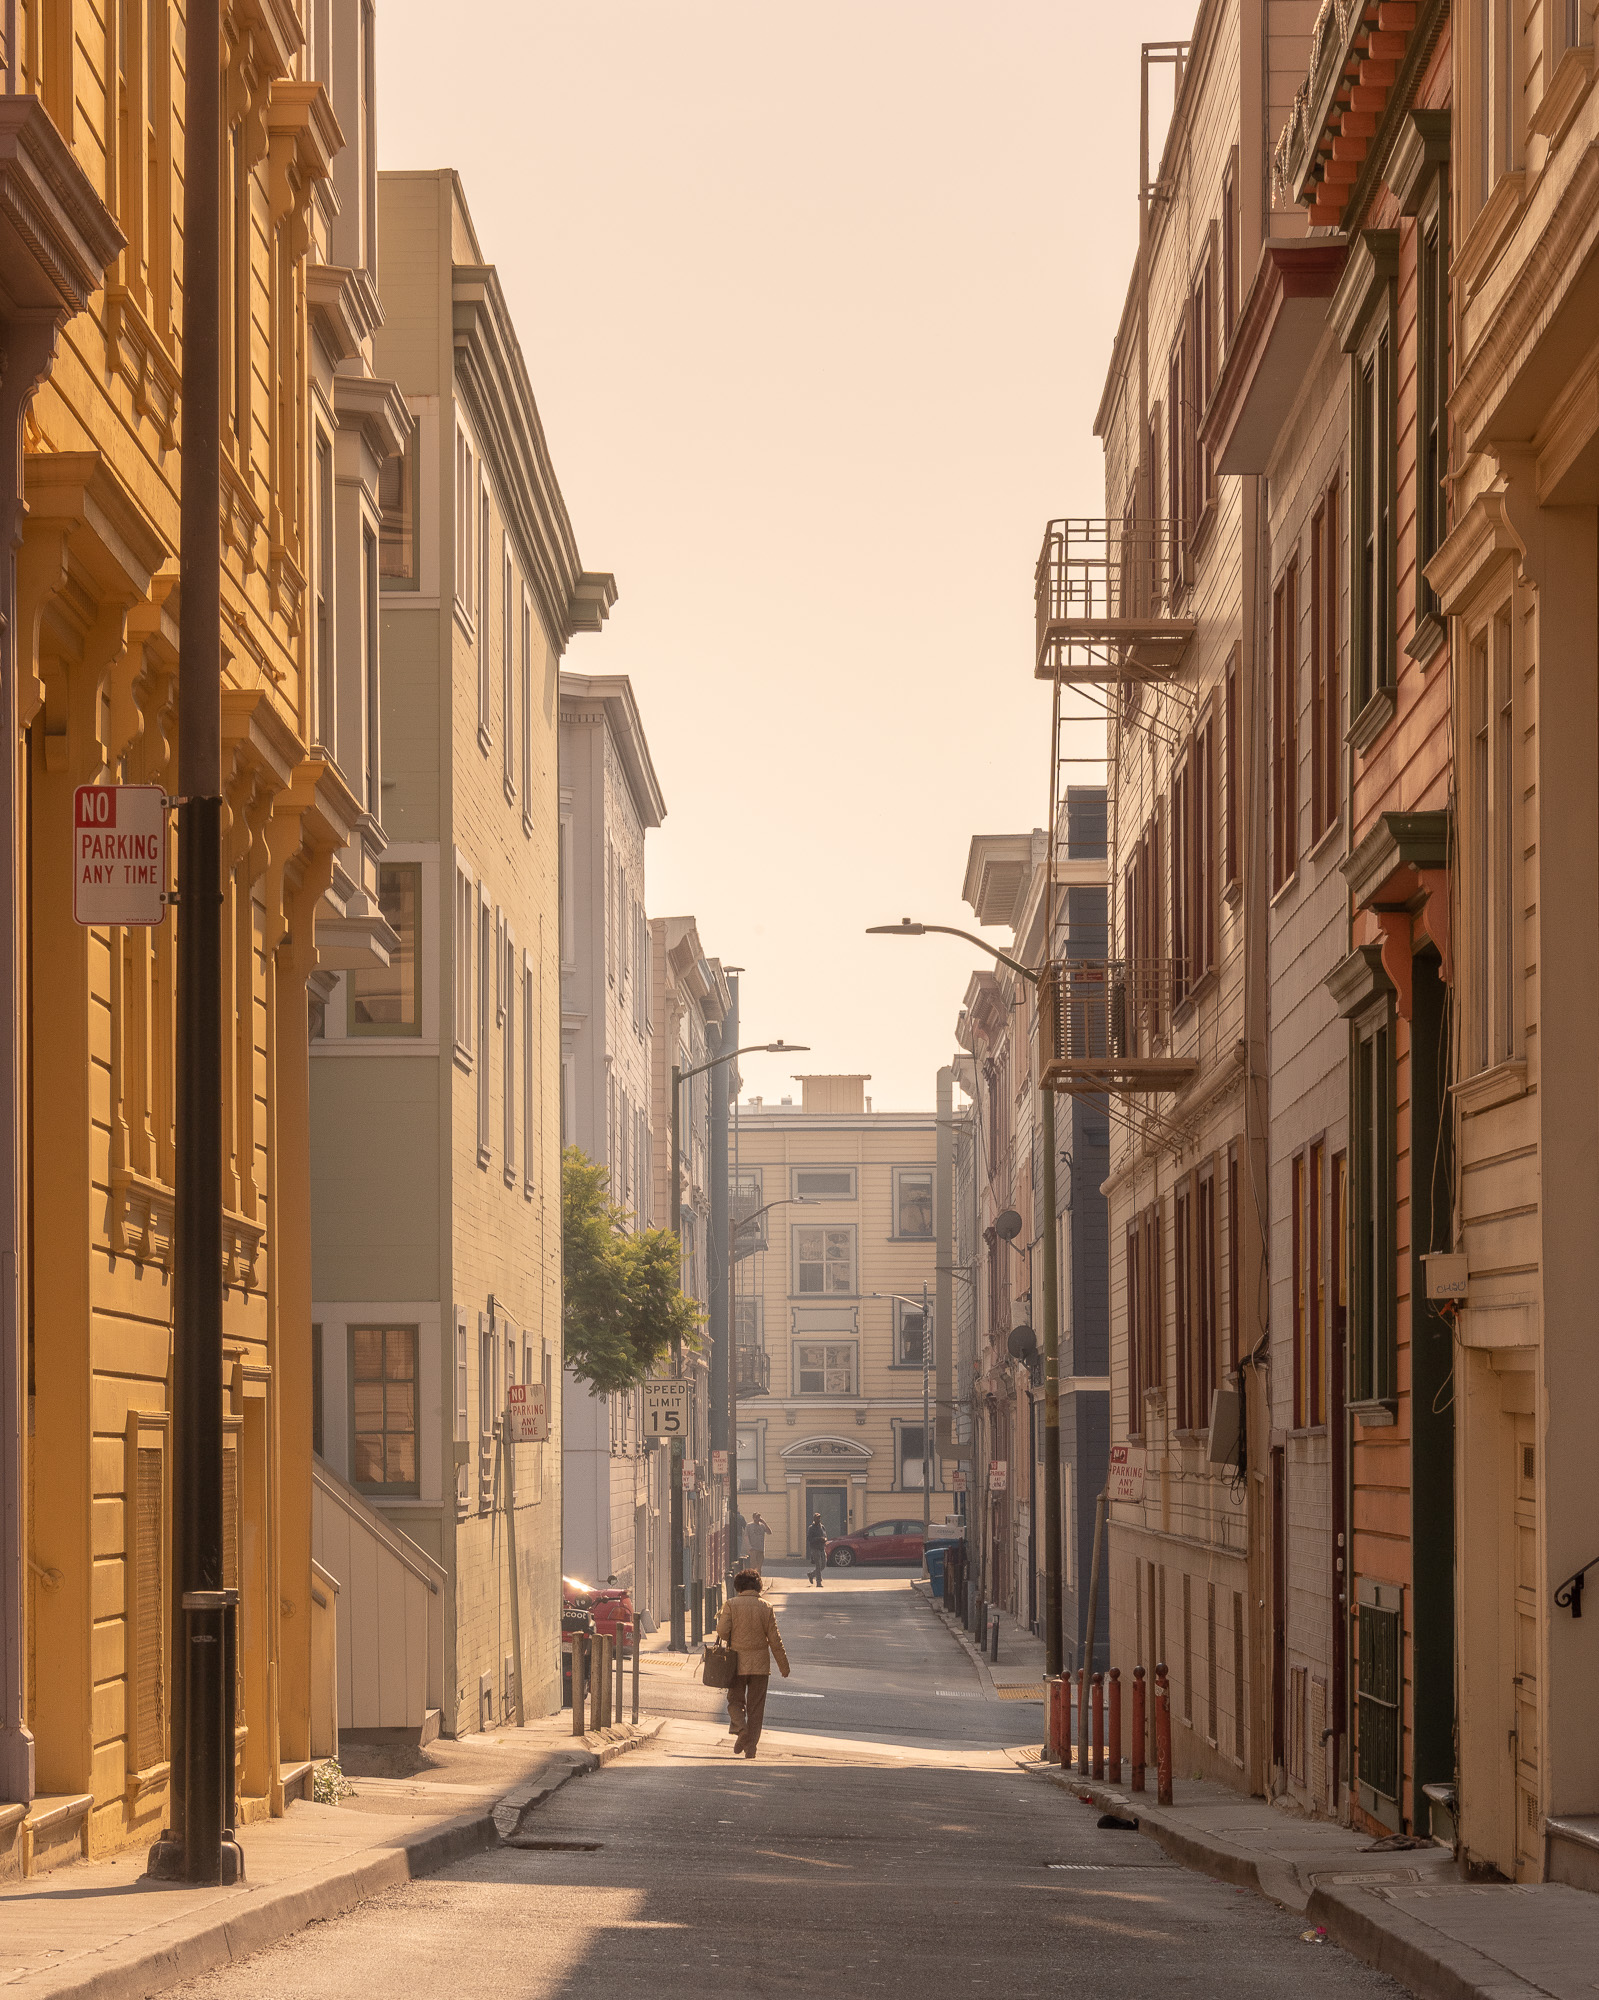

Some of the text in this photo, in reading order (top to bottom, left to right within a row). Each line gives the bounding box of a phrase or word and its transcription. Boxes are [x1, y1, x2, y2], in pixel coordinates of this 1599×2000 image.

[82, 792, 109, 823] NO
[82, 834, 158, 860] PARKING
[82, 865, 158, 885] ANY TIME
[511, 1388, 524, 1401] NO
[645, 1385, 686, 1394] SPEED
[649, 1398, 681, 1407] LIMIT
[512, 1404, 544, 1416] PARKING
[521, 1417, 537, 1426] ANY
[651, 1410, 681, 1431] 15
[521, 1427, 538, 1436] TIME
[1113, 1449, 1126, 1462] NO
[1112, 1466, 1143, 1478] PARKING
[1119, 1478, 1134, 1487] ANY
[1117, 1487, 1134, 1496] TIME
